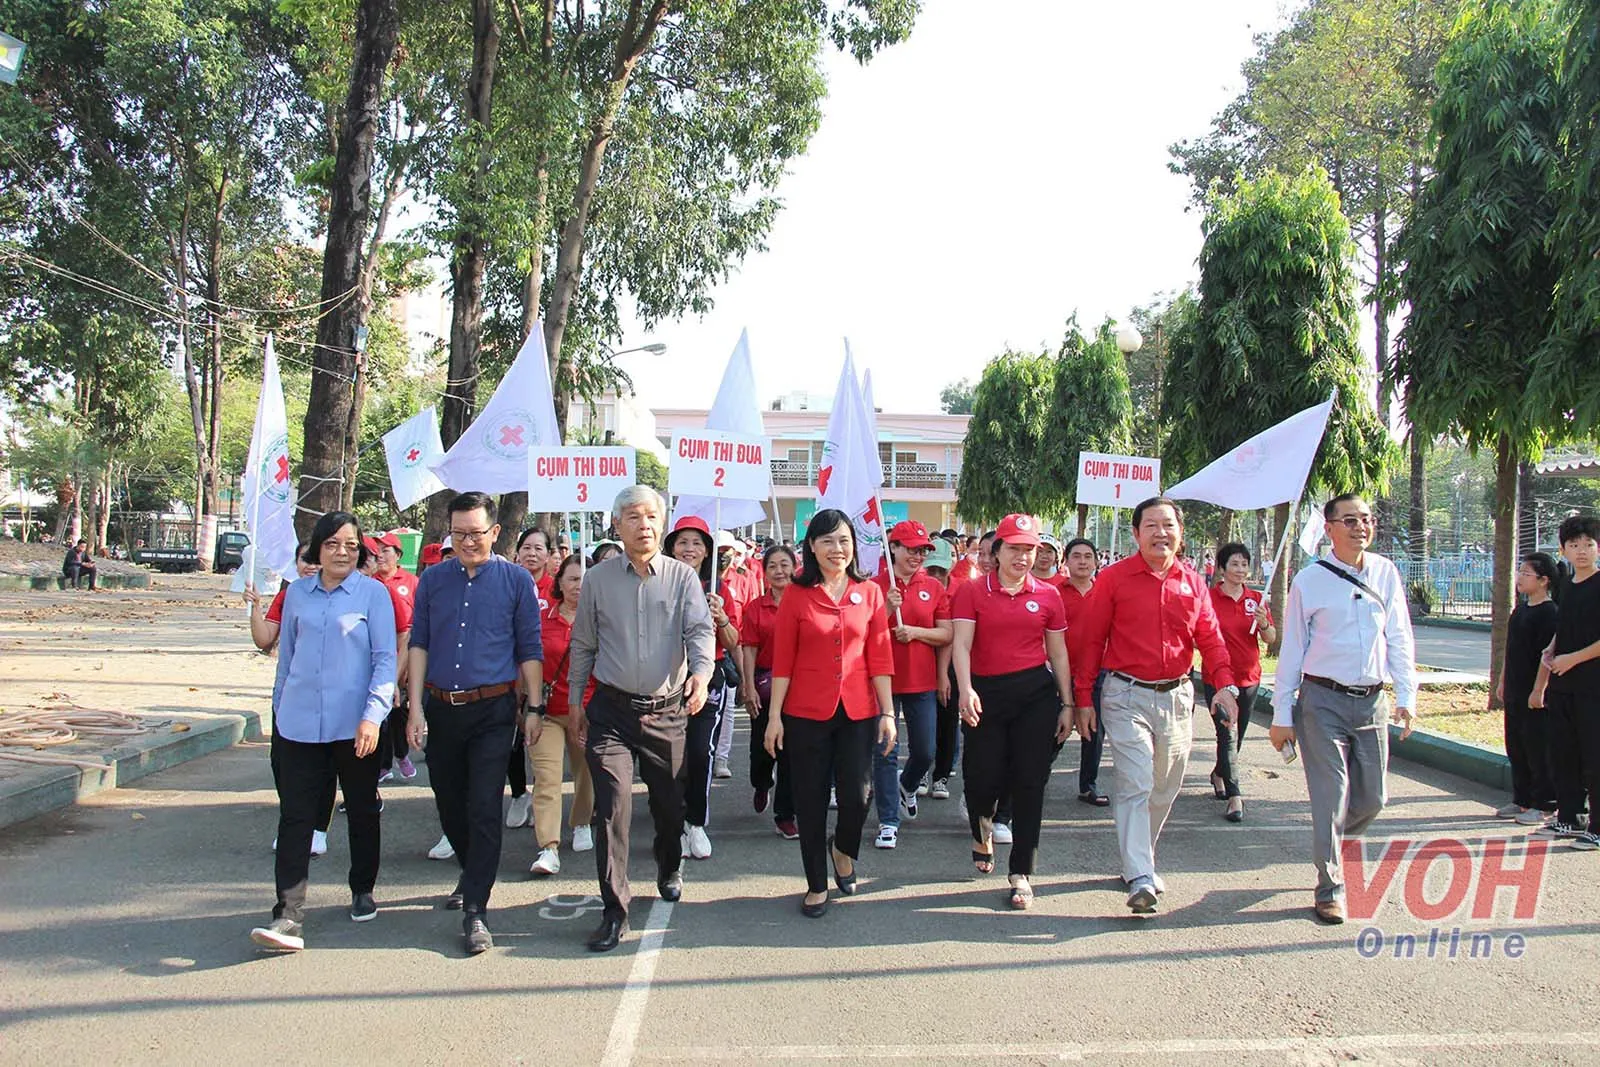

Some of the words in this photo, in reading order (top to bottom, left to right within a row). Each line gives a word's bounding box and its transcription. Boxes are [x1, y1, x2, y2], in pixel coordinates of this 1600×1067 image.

[678, 437, 710, 463] CỤM
[713, 441, 734, 462] THI
[736, 444, 763, 465] ĐUA
[536, 456, 569, 481] CỤM
[573, 456, 596, 477] THI
[598, 456, 628, 477] ĐUA
[713, 467, 726, 487] 2
[1084, 460, 1110, 480] CỤM
[1112, 463, 1129, 479] THI
[1131, 464, 1153, 482] ĐUA
[576, 482, 588, 503] 3
[1114, 483, 1121, 499] 1
